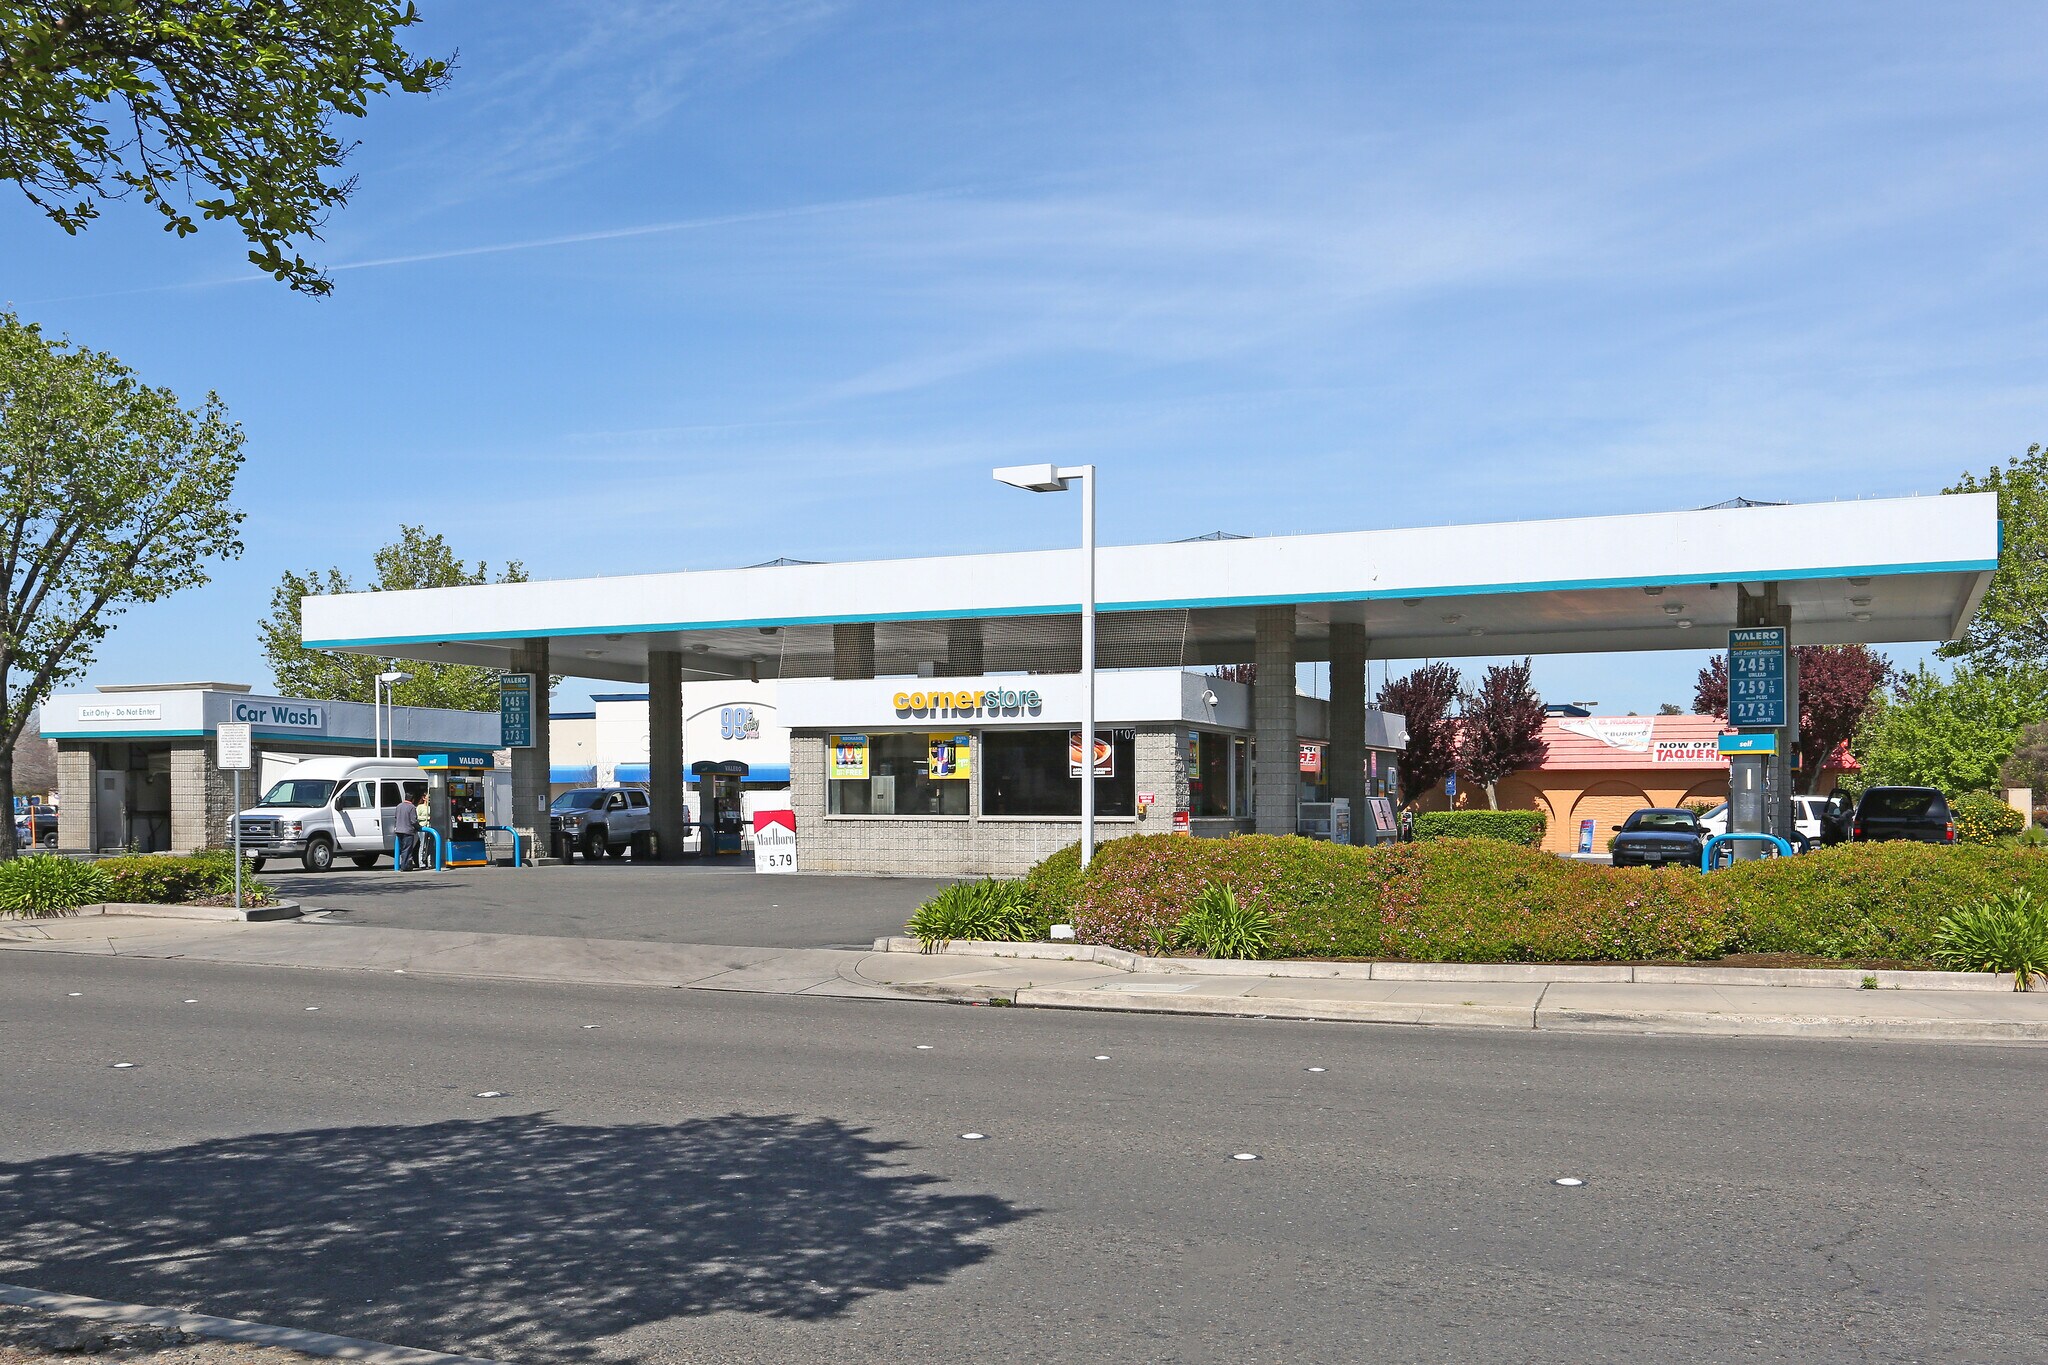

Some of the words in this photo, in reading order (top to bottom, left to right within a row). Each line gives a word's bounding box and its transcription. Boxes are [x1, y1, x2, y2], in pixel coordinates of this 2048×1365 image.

[1734, 631, 1779, 641] VALERO
[1738, 657, 1766, 672] 2.45
[1738, 680, 1766, 694] 2.59
[893, 686, 1040, 709] cornerstore
[82, 709, 94, 717] Exit
[95, 709, 110, 718] Only
[116, 708, 125, 716] Do
[126, 708, 138, 716] Not
[139, 708, 156, 716] Enter
[236, 704, 267, 722] Car
[271, 706, 319, 726] Wash
[1738, 703, 1766, 717] 2.73
[1739, 740, 1753, 748] self
[459, 756, 484, 765] VALERO
[756, 828, 794, 846] Marlboro
[769, 854, 792, 867] 5.79
